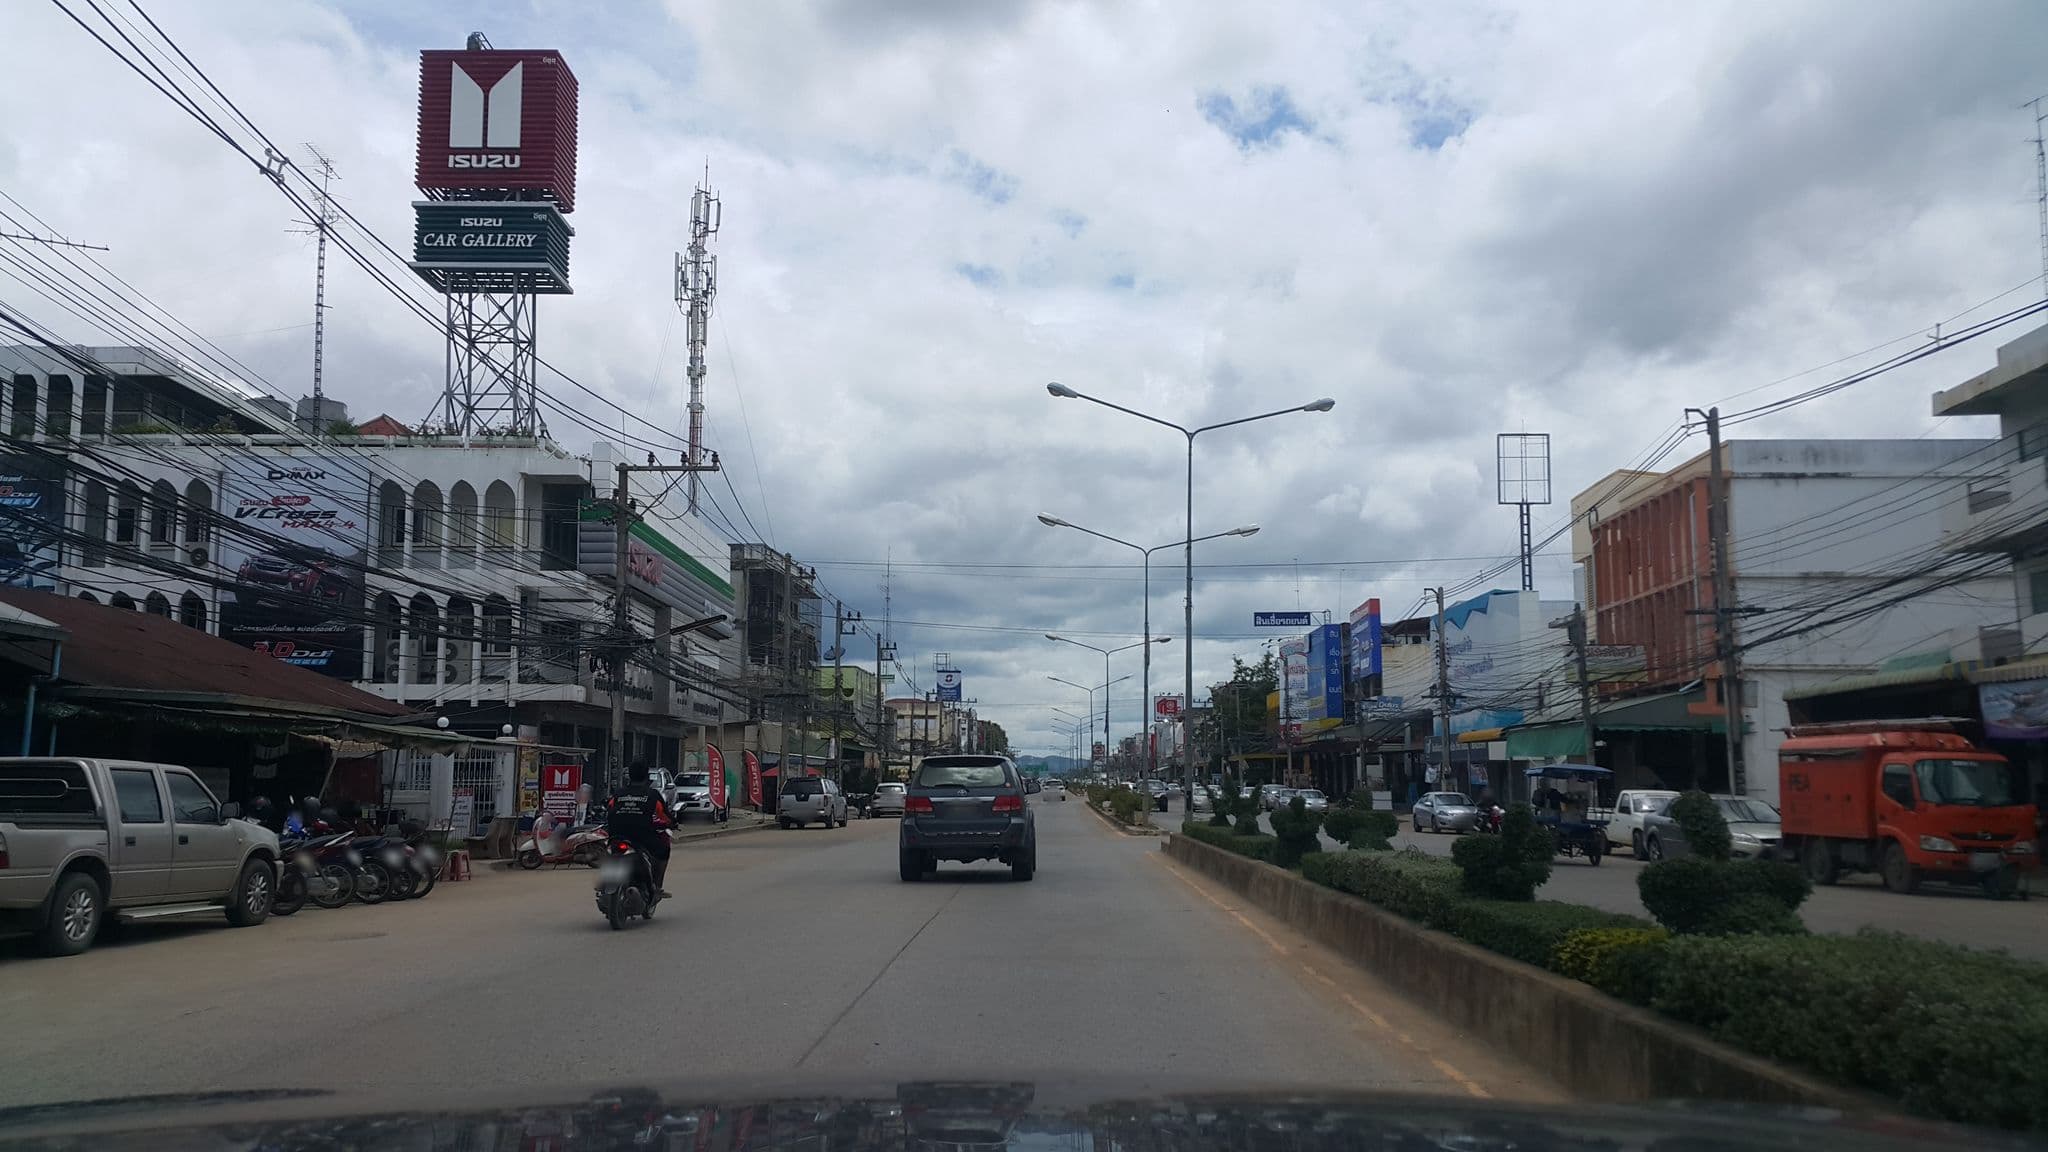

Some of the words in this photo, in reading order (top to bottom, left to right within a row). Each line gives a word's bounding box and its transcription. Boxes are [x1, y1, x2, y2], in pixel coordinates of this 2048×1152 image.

[448, 154, 521, 168] ISUZU
[461, 218, 502, 227] ISUZU
[423, 233, 457, 247] CAR
[462, 233, 538, 247] GALLERY
[1256, 613, 1309, 626] สินเชื่อรถยนต์
[711, 757, 721, 796] ISUZU
